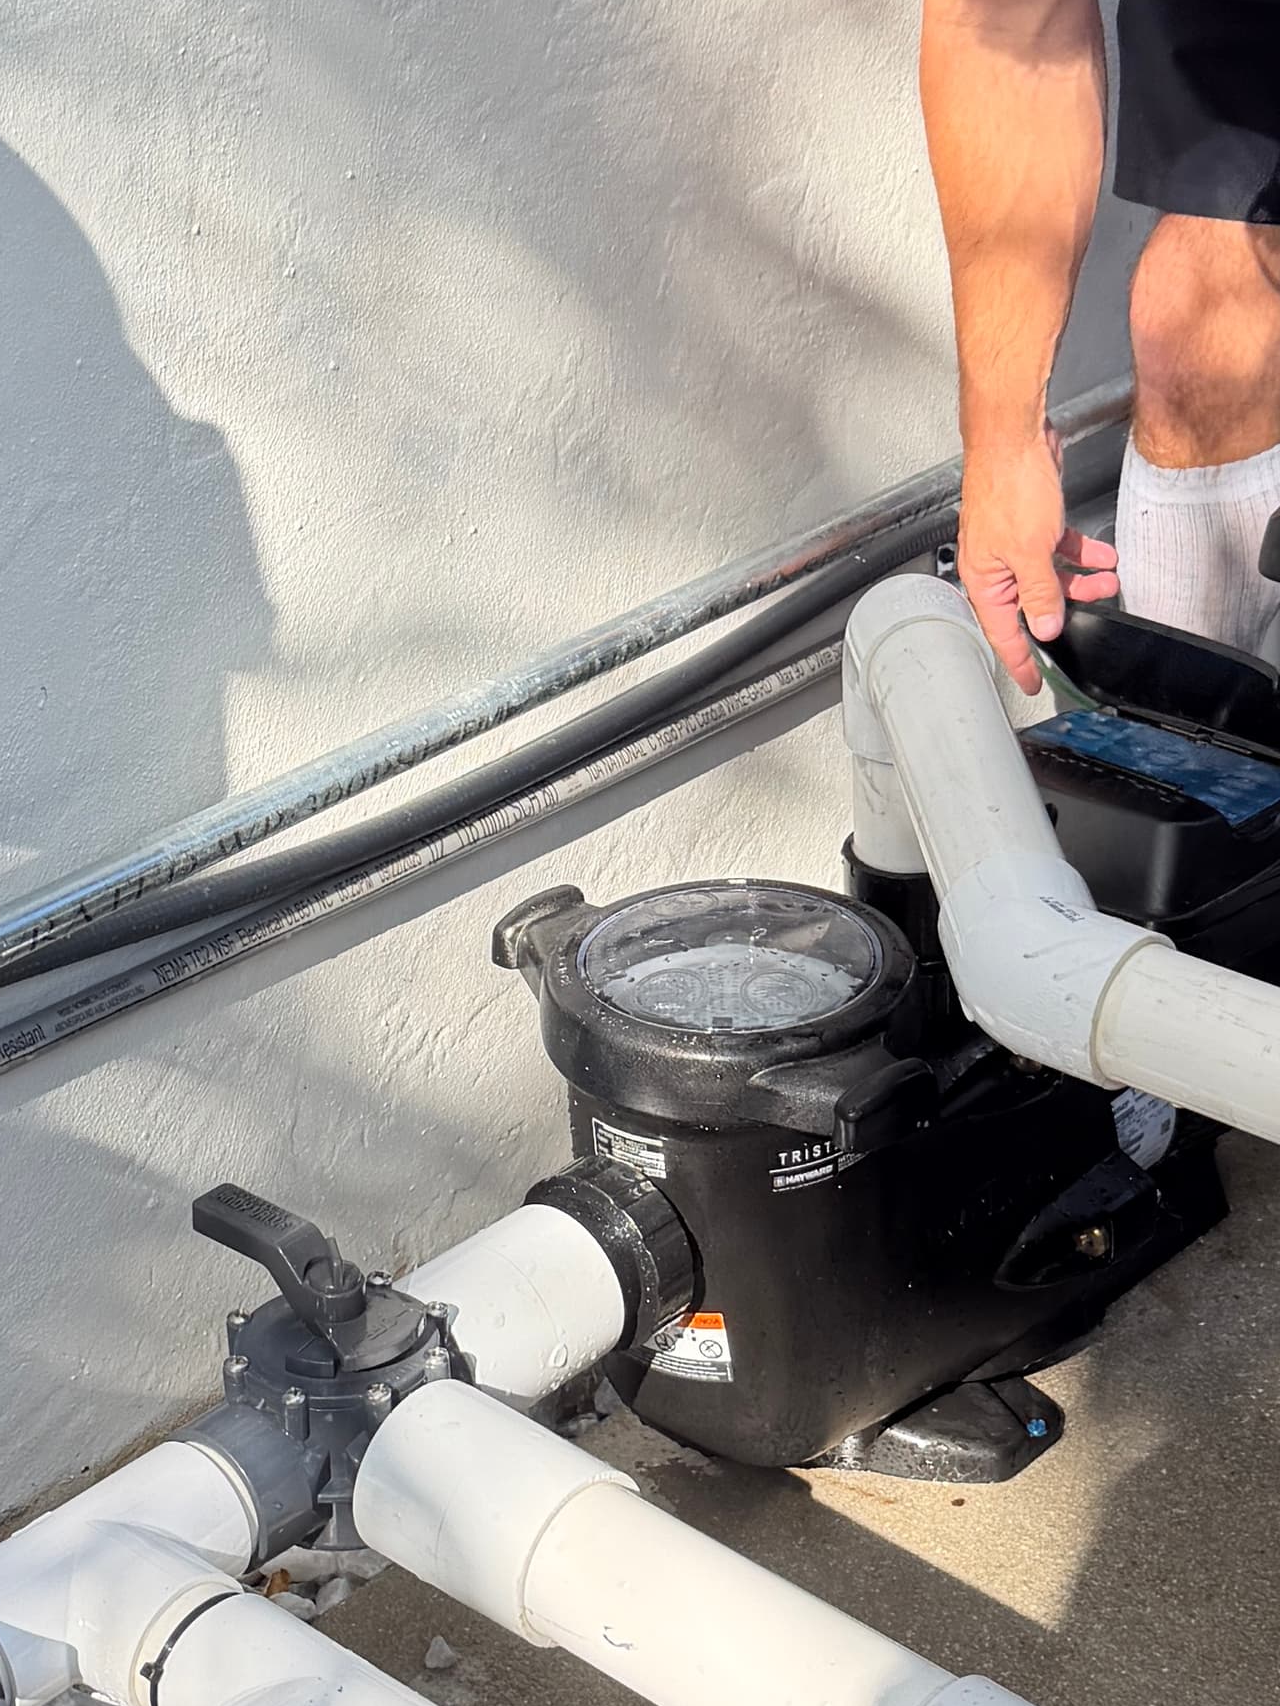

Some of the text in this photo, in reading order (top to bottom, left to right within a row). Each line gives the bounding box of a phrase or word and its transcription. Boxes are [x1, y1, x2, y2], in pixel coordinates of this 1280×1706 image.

[152, 955, 188, 986] NEMA
[187, 948, 211, 974] TC2
[211, 933, 235, 962] NSF
[237, 911, 285, 952] Electrical
[283, 897, 313, 930] UL651
